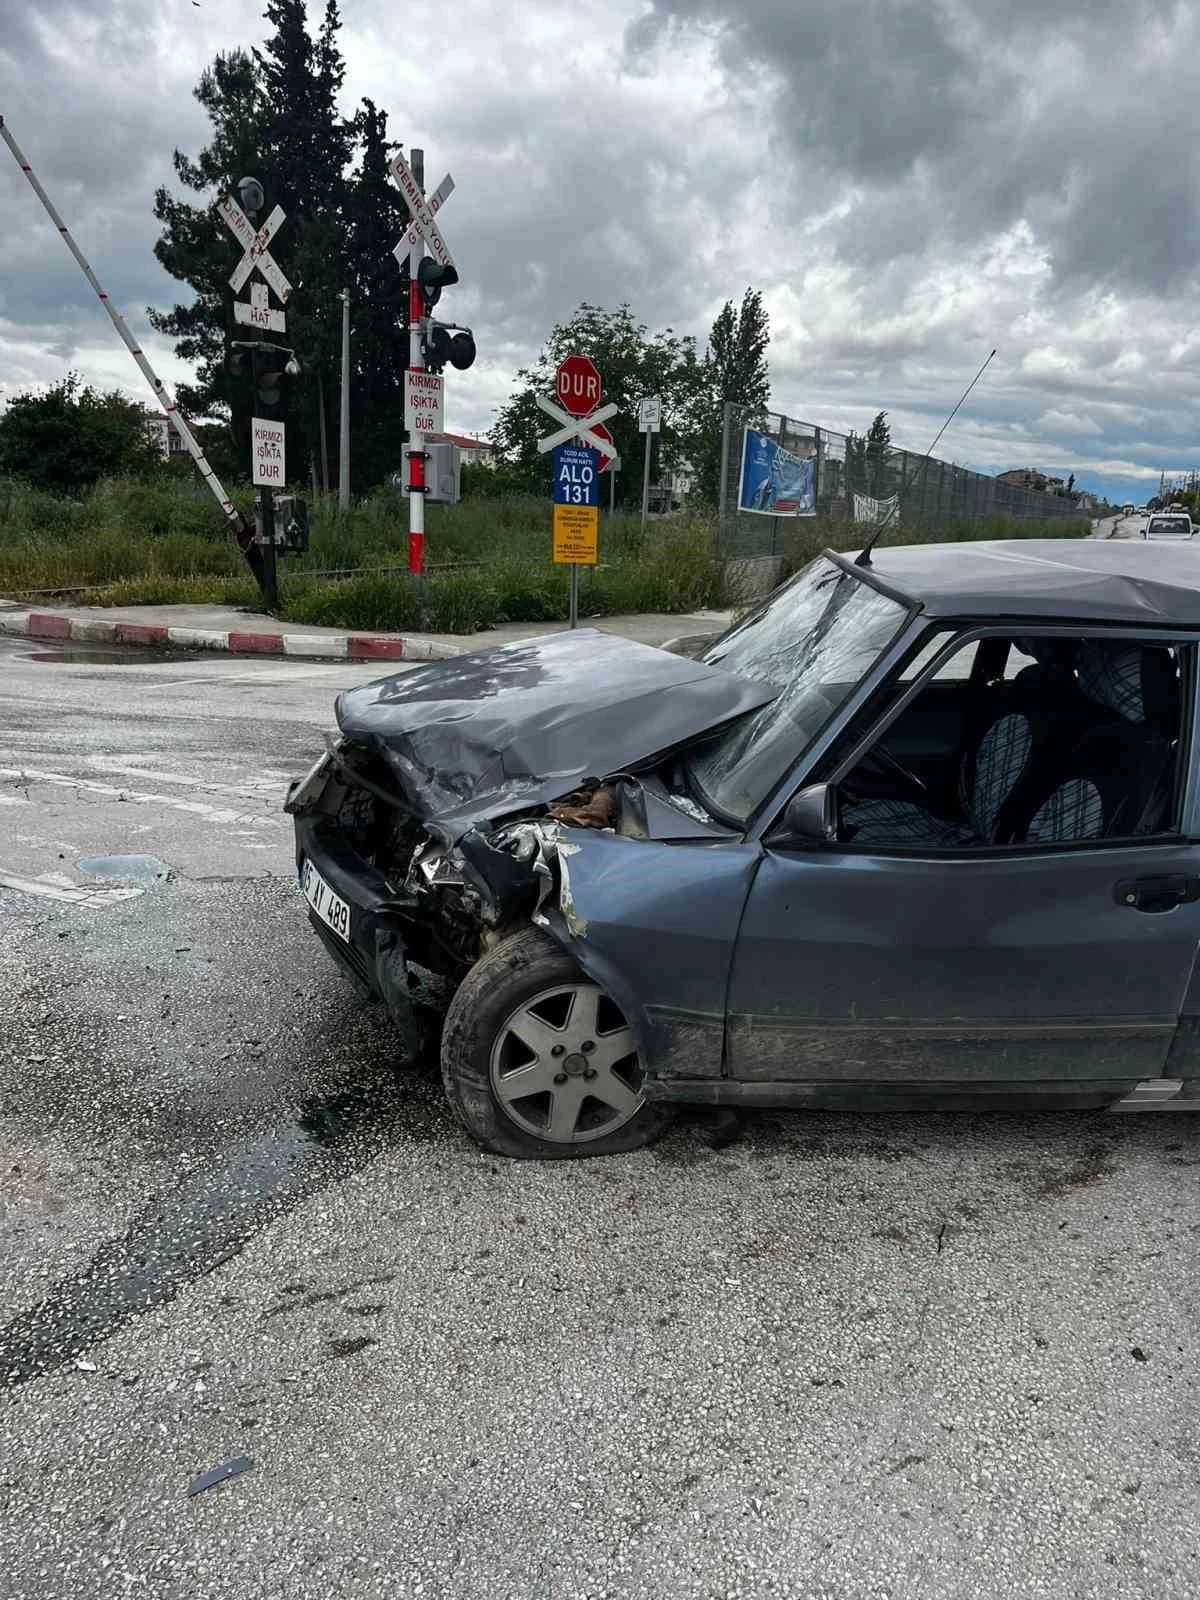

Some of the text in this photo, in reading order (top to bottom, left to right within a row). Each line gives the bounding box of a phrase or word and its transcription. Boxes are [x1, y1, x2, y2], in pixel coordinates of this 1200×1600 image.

[251, 309, 271, 325] HAT
[409, 374, 441, 391] KIRMIZI
[560, 372, 597, 399] DUR
[415, 416, 434, 431] DUR
[255, 428, 283, 444] KIRMIZI
[259, 463, 280, 478] DUR
[560, 465, 593, 484] ALO
[562, 484, 590, 503] 131
[328, 895, 348, 935] 489
